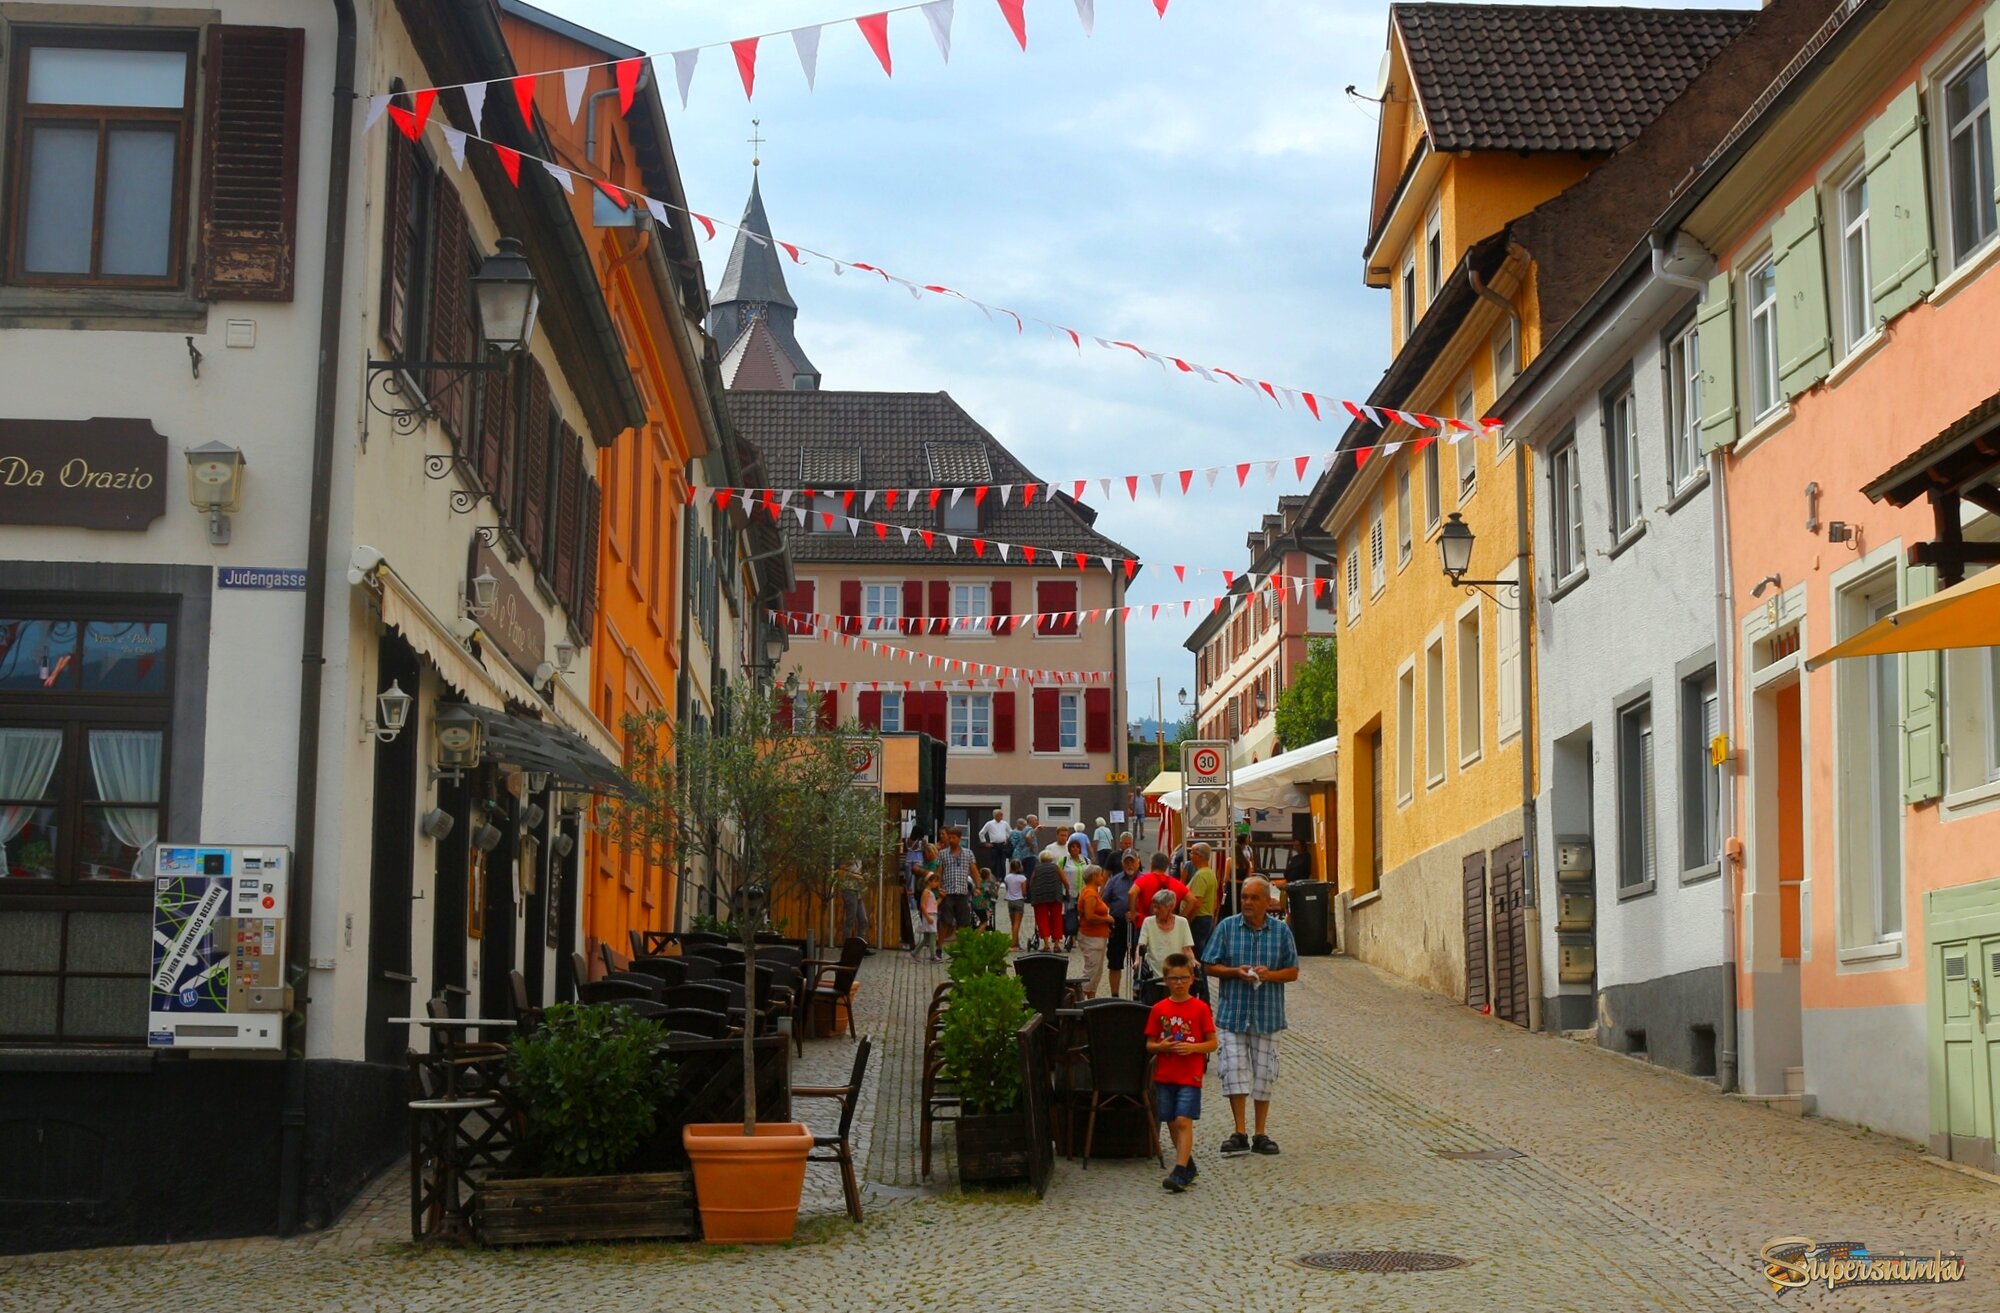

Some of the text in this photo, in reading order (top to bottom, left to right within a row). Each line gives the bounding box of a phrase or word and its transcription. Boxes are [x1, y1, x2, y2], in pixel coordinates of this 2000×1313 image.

[0, 456, 153, 488] Da Orazio
[225, 570, 306, 589] Judengasse
[1199, 756, 1215, 769] 30
[1197, 776, 1217, 784] ZONE
[168, 886, 223, 974] HIER KONTAKTLOS BEZAHLEN
[182, 990, 195, 1004] KSC
